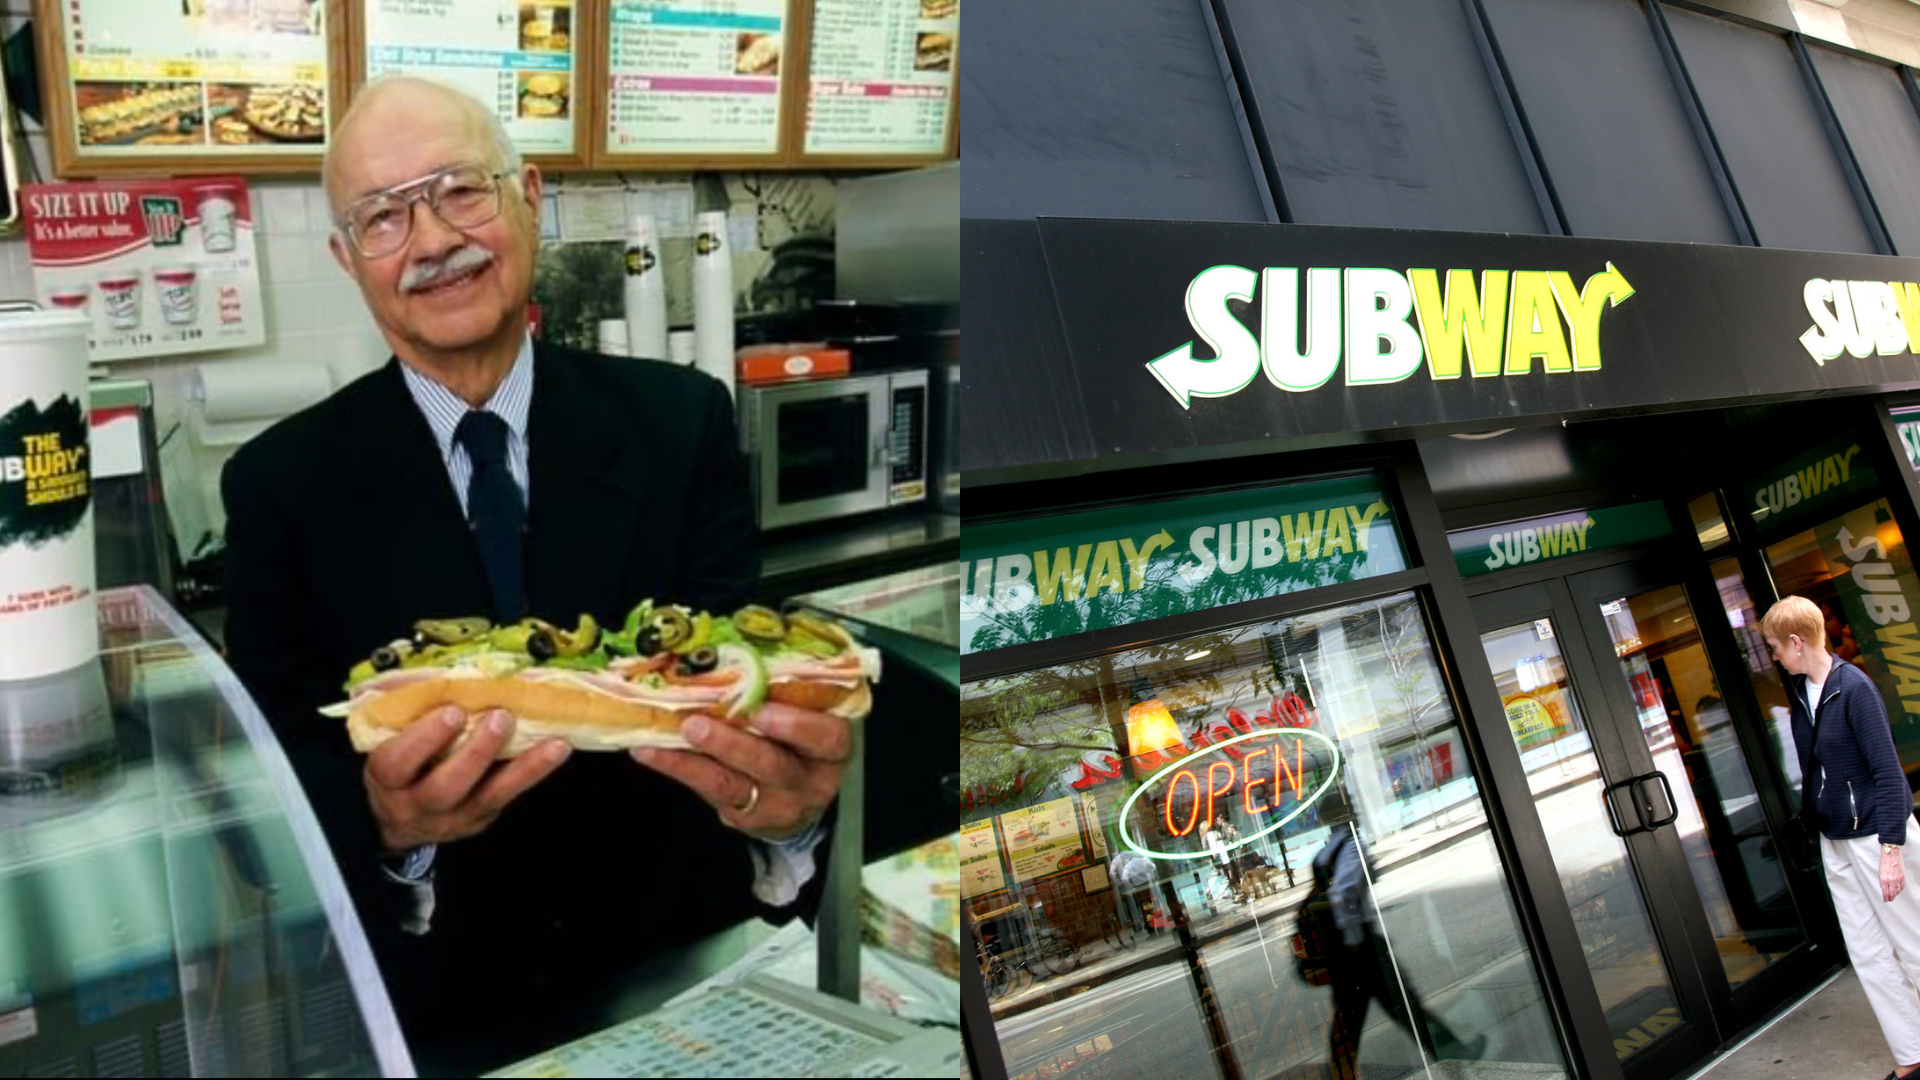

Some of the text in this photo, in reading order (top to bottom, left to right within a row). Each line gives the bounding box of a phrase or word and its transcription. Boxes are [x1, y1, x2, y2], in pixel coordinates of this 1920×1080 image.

[30, 192, 130, 218] SIZE IT UP
[35, 222, 53, 240] It's
[63, 221, 98, 239] better
[1145, 258, 1636, 411] SUBWAY
[24, 432, 60, 454] THE
[0, 448, 80, 482] BWAY
[1751, 443, 1861, 524] SUBWAY
[1176, 499, 1391, 587] SUBWAY
[1484, 516, 1597, 571] SUBWAY
[1506, 705, 1523, 715] COME
[1508, 707, 1539, 721] BUILD YOUR
[1513, 723, 1544, 737] BREAKFAST
[1164, 738, 1304, 837] OPEN
[1028, 803, 1046, 815] Kids
[969, 854, 988, 864] Subs
[1034, 843, 1056, 854] Salads
